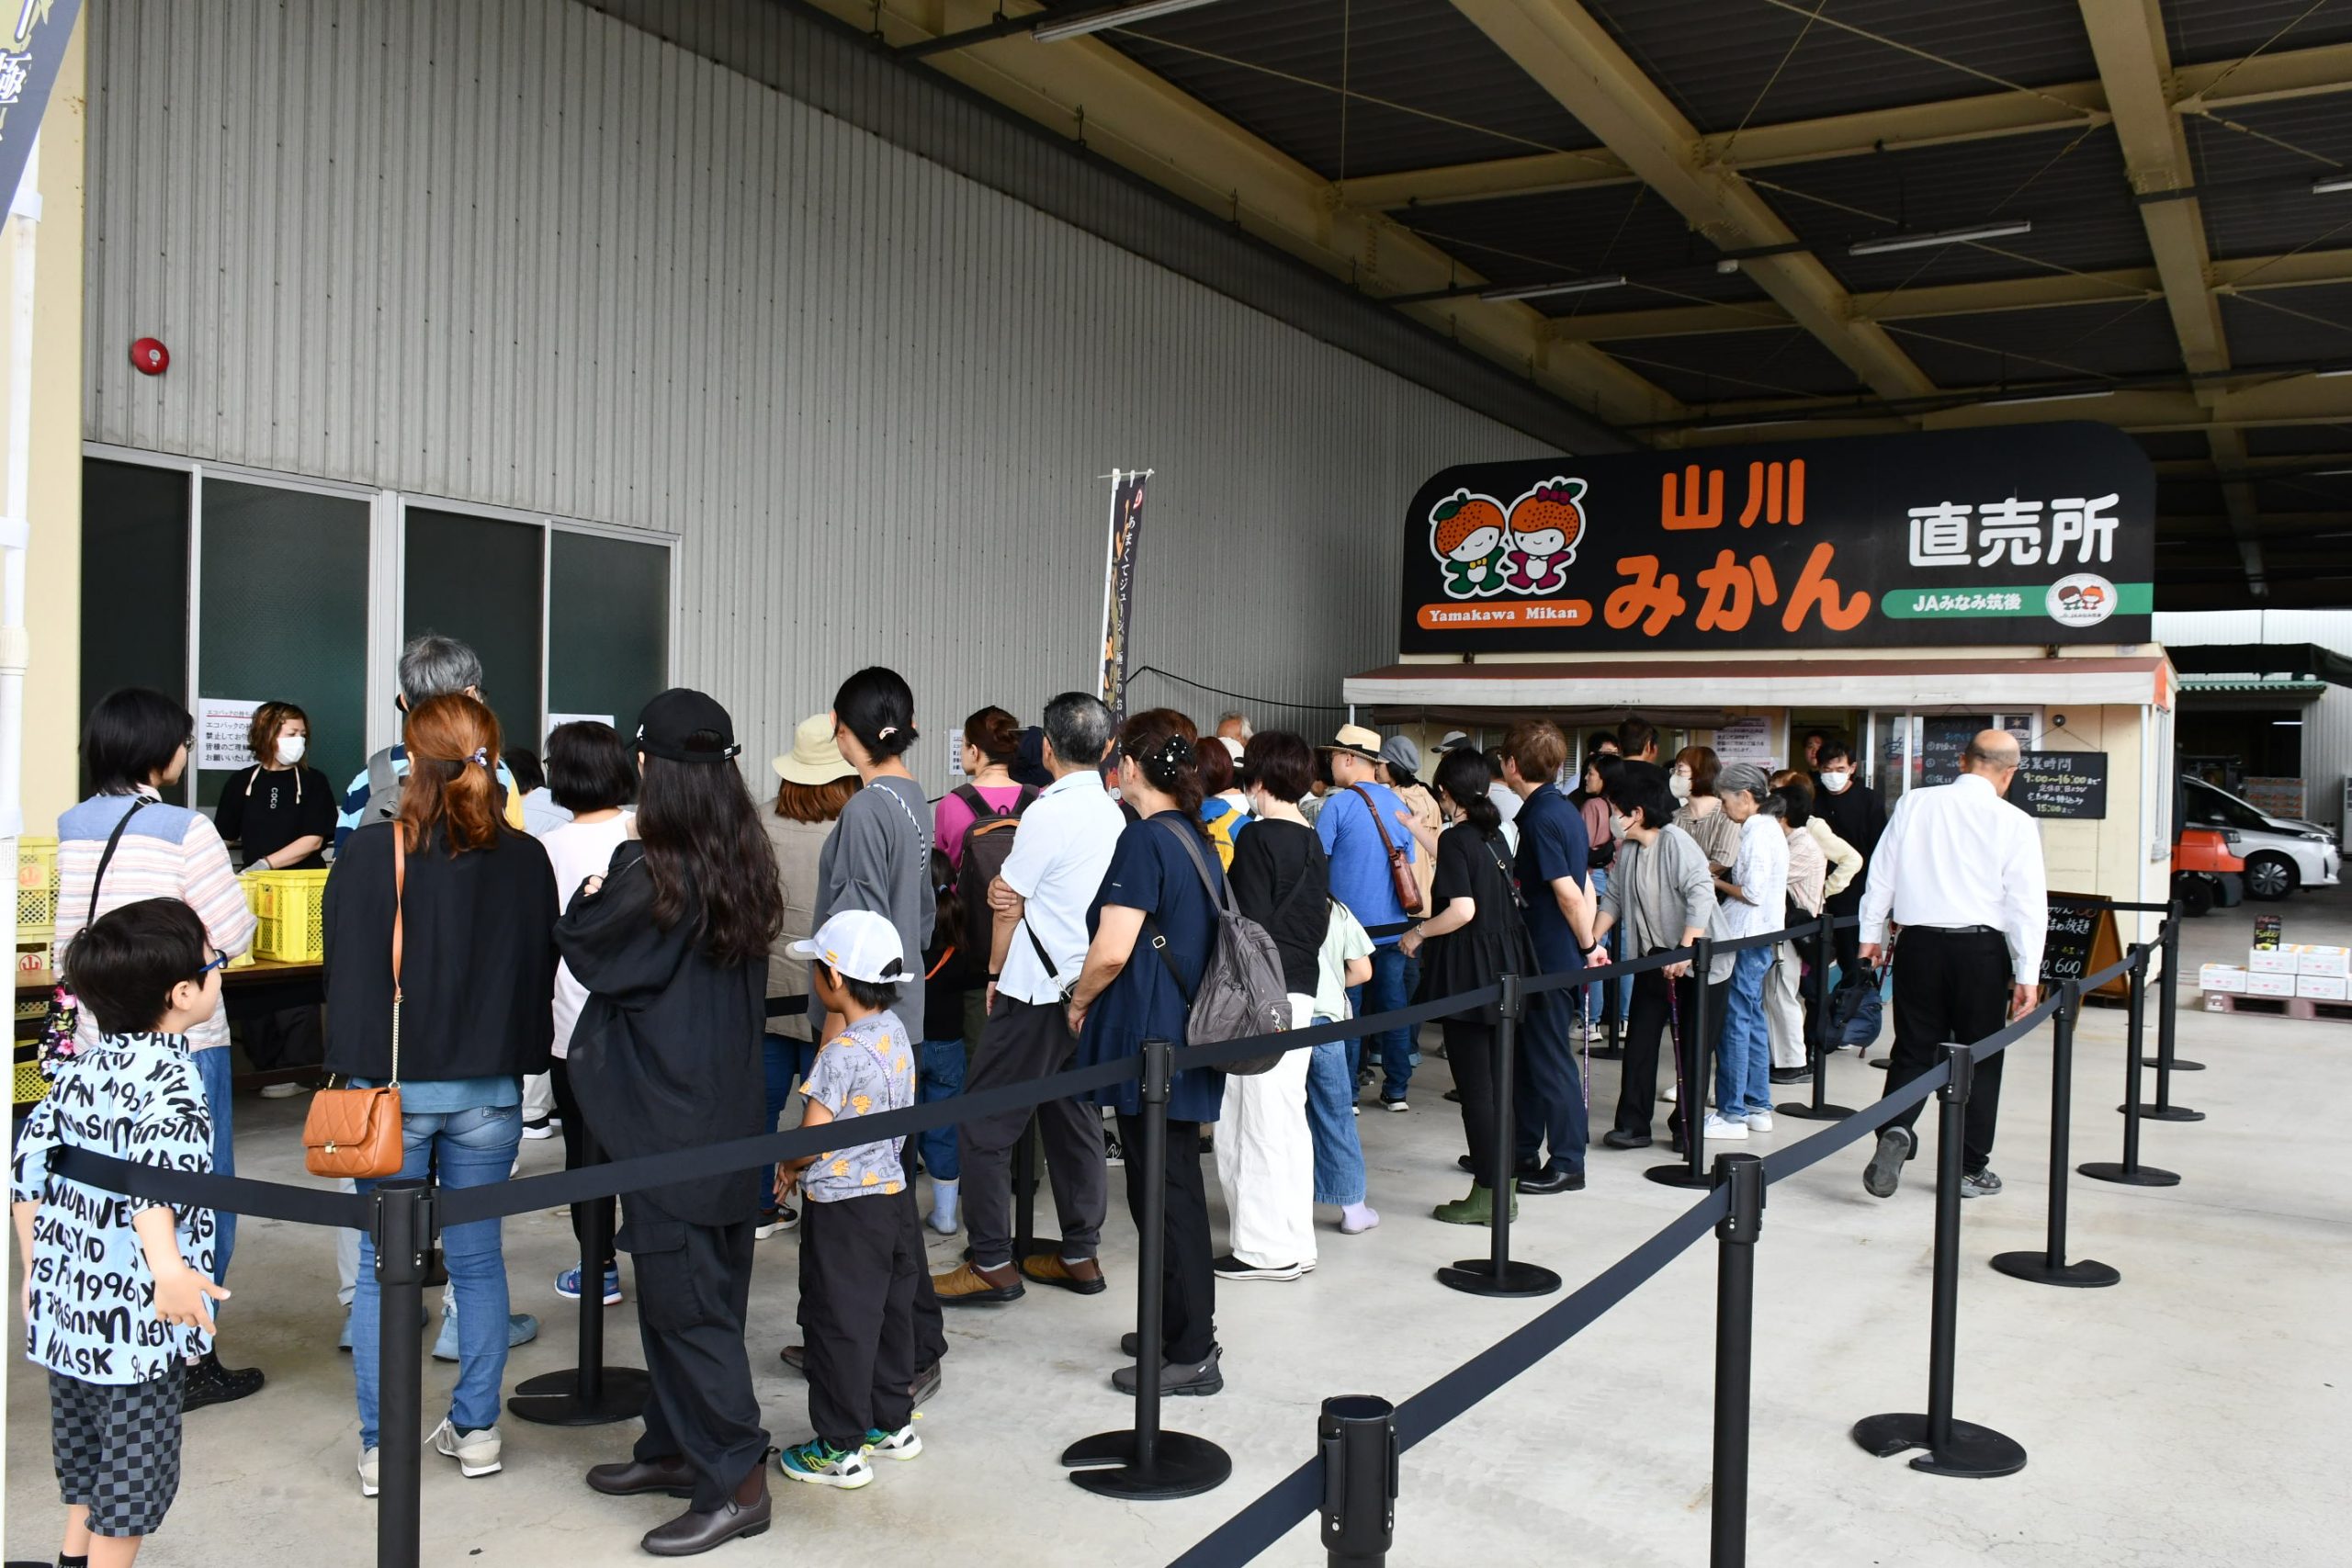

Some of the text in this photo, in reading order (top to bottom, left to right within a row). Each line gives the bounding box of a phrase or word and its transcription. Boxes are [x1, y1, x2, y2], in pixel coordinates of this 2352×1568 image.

[1660, 458, 1805, 530] 山川
[1907, 493, 2120, 568] 直売所
[1603, 542, 1871, 637] みかん
[1912, 593, 2022, 612] JAみなみ筑後
[1429, 605, 1578, 625] Yamakawa Mikan
[2055, 957, 2081, 975] 600
[74, 1269, 136, 1303] 1996
[46, 1331, 113, 1375] WASK
